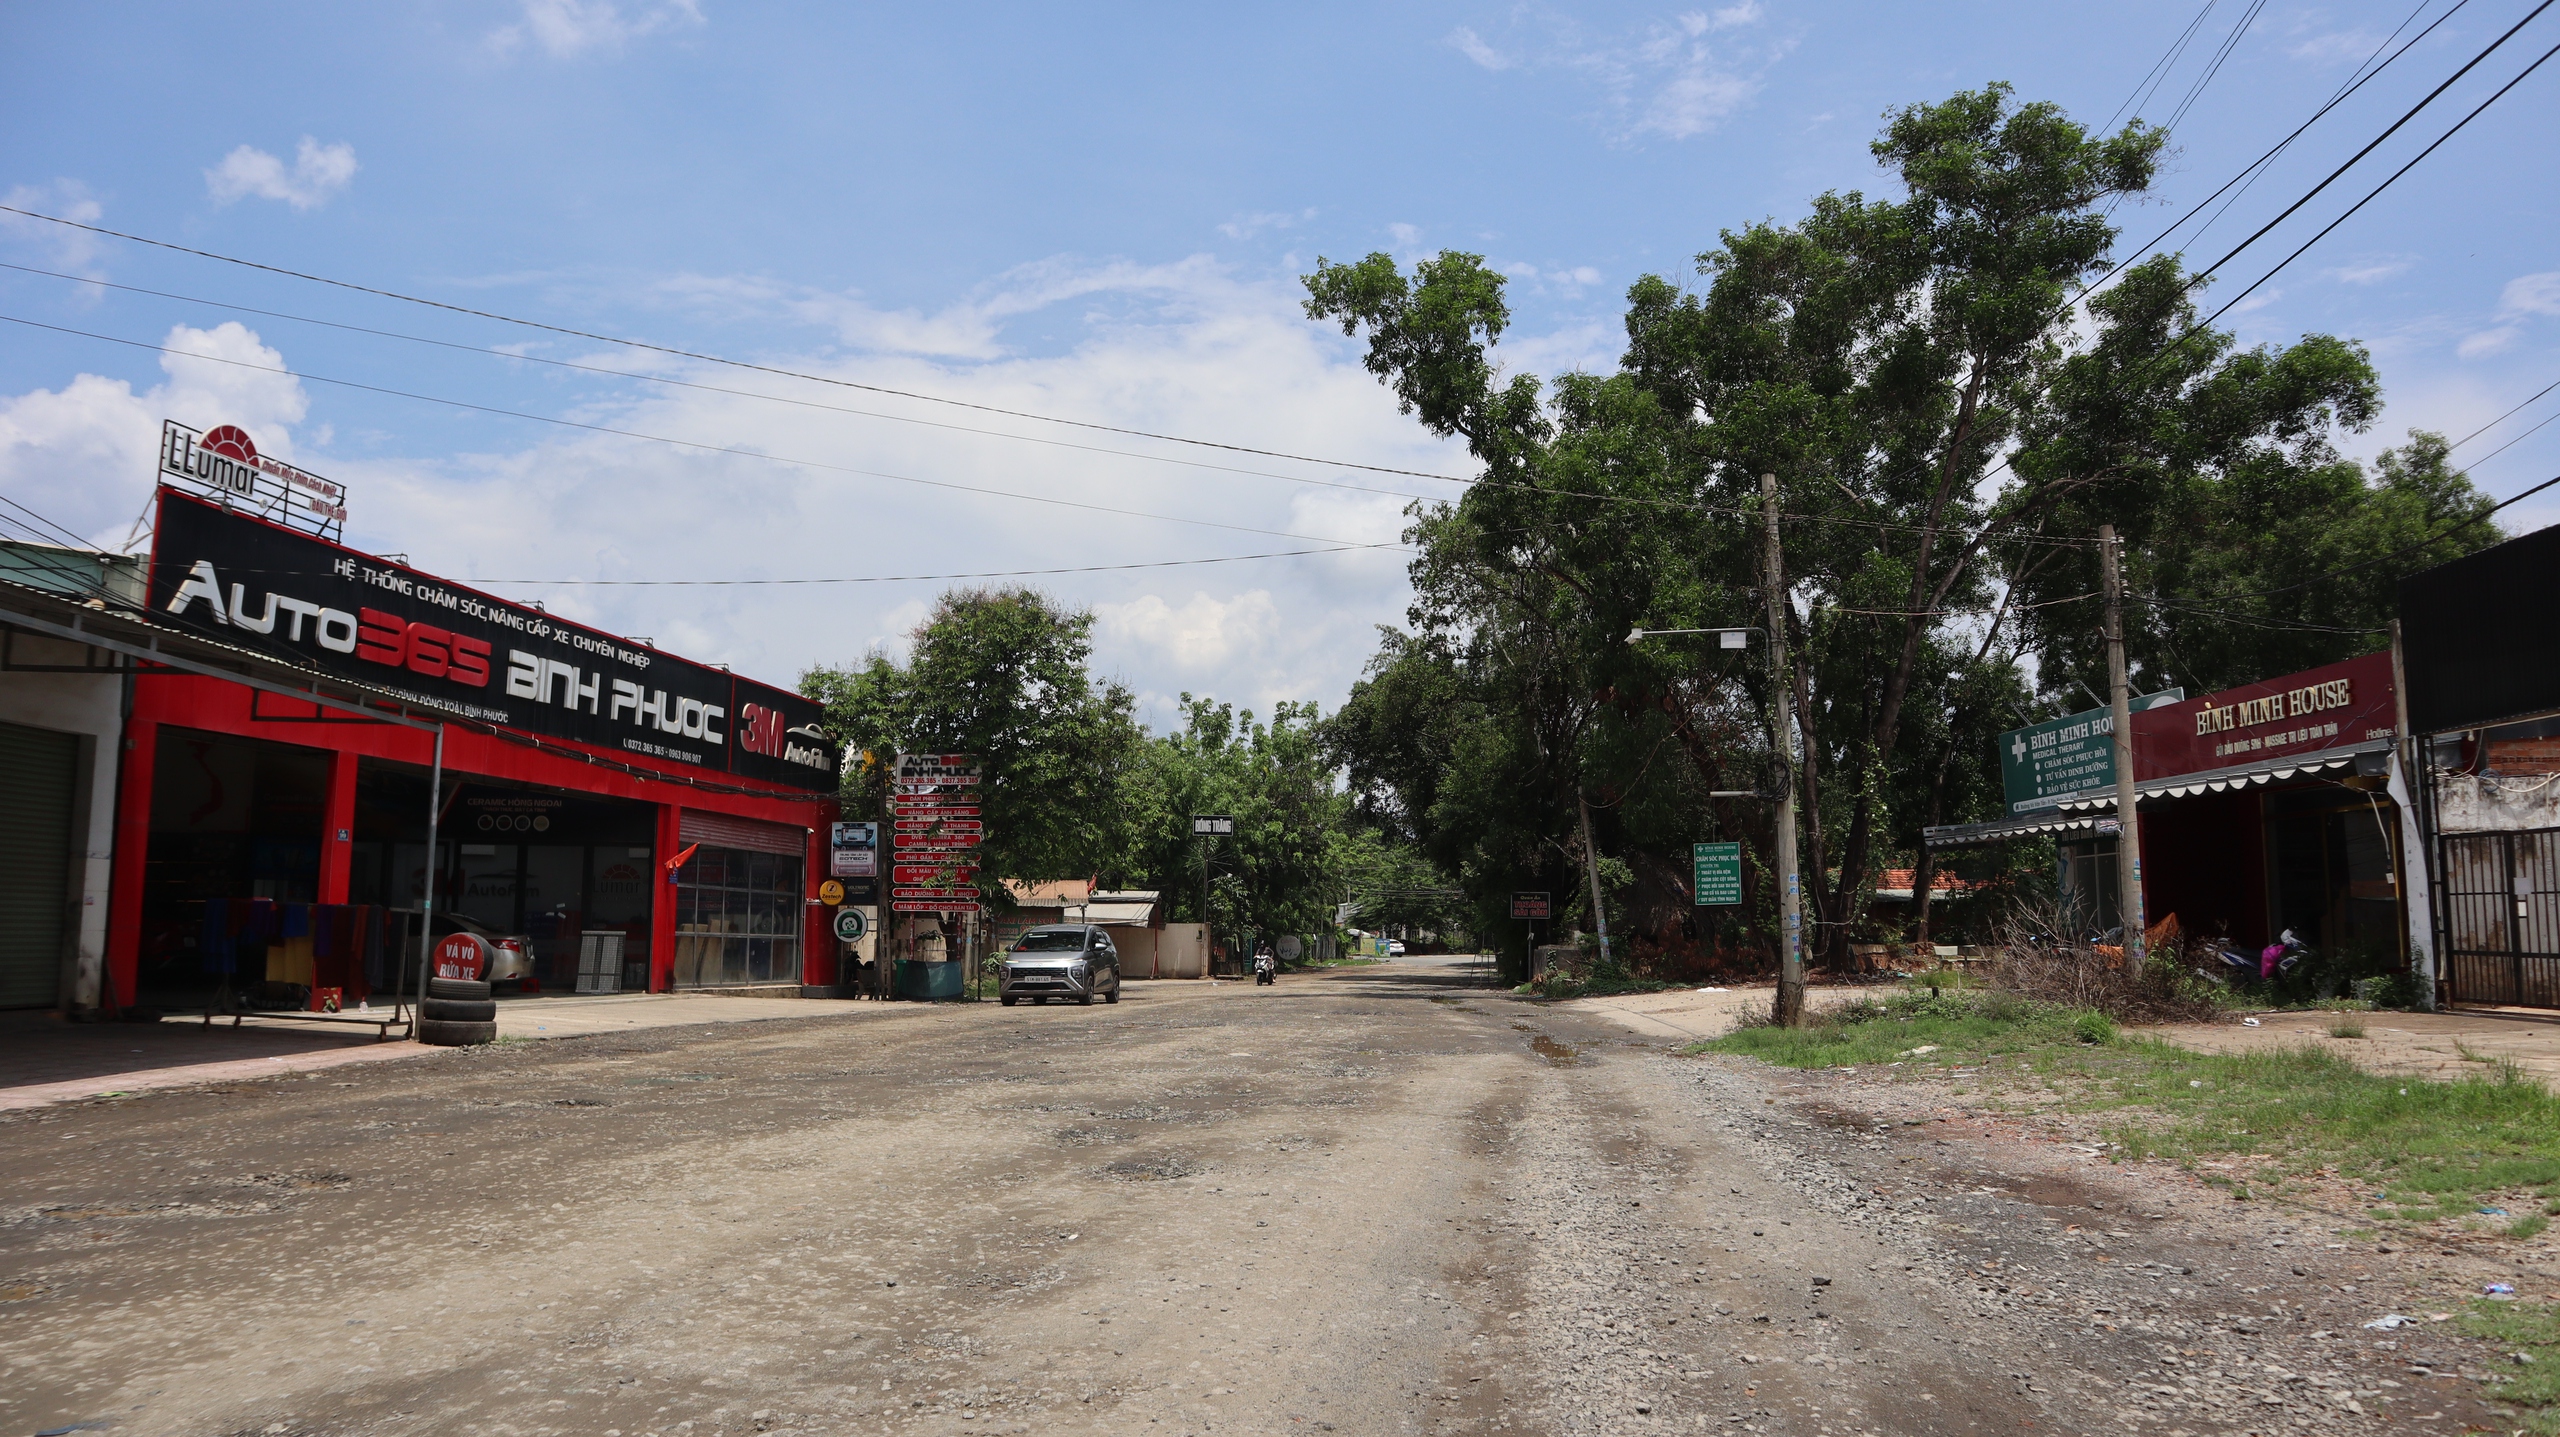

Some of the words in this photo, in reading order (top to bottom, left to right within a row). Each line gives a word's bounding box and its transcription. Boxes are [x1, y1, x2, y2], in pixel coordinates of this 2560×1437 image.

[334, 558, 357, 581] HỆ
[362, 567, 412, 597] THỐNG
[416, 586, 457, 611] CHĂM
[488, 608, 525, 632] NÂNG
[526, 616, 550, 639] CẤP
[553, 628, 569, 645] XE
[573, 635, 615, 660] CHUYÊN
[618, 649, 650, 671] NGHIỆP
[2196, 701, 2235, 736] BÌNH
[2238, 694, 2285, 727] MINH
[2288, 678, 2350, 717] HOUSE
[483, 709, 508, 723] PHƯỚC
[740, 703, 784, 759] 3M
[2030, 731, 2056, 750] BÌNH
[2059, 723, 2089, 743] MINH
[628, 739, 642, 751] 0372
[643, 743, 652, 753] 365
[654, 746, 664, 756] 365
[2033, 748, 2057, 760] MEDICAL
[784, 742, 830, 771] AutoFilm
[2062, 754, 2074, 765] SÓC
[2068, 766, 2084, 777] DINH
[2085, 761, 2108, 773] DƯỠNG
[2047, 782, 2059, 794] BẢO
[467, 798, 506, 806] CERAMIC
[1195, 818, 1211, 832] BÓNG
[1212, 818, 1231, 832] TRĂNG
[468, 881, 539, 897] AutoFm
[592, 876, 640, 894] Lumar
[446, 942, 458, 958] VÁ
[462, 943, 474, 960] VỎ
[439, 961, 459, 978] RỬA
[462, 967, 475, 980] XE
